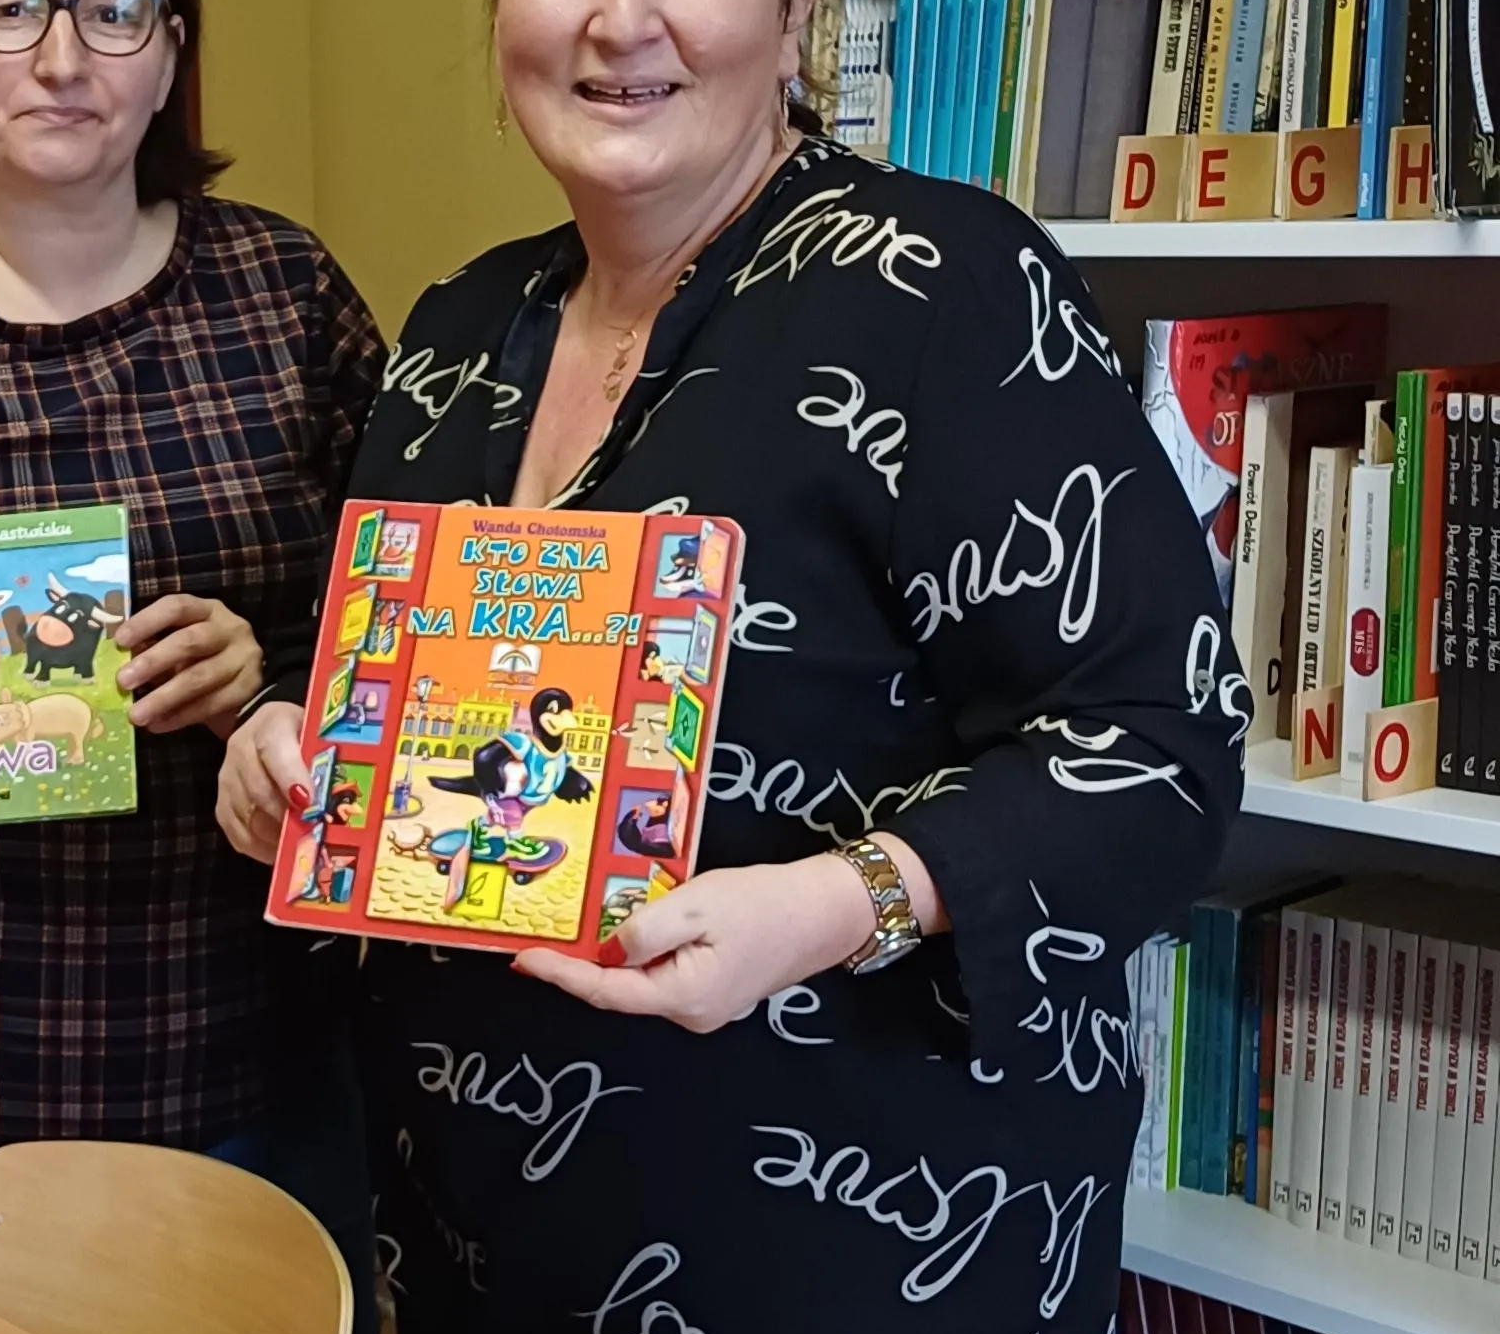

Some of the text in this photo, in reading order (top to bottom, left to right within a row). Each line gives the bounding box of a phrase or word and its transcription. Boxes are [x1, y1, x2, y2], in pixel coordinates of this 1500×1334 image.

[1203, 67, 1217, 129] FIEDLER
[1123, 153, 1156, 210] D
[1198, 149, 1229, 208] E
[1290, 145, 1326, 206] G
[1397, 143, 1431, 205] H
[472, 519, 607, 540] Wanda Chotomska
[1242, 462, 1261, 564] Powrót Daleków
[459, 536, 610, 571] KTO ZNA
[1306, 526, 1324, 633] SZKOLNY LUD
[471, 568, 583, 601] SŁOWA
[407, 606, 456, 637] NA
[1303, 701, 1335, 766] N
[1373, 720, 1411, 784] O
